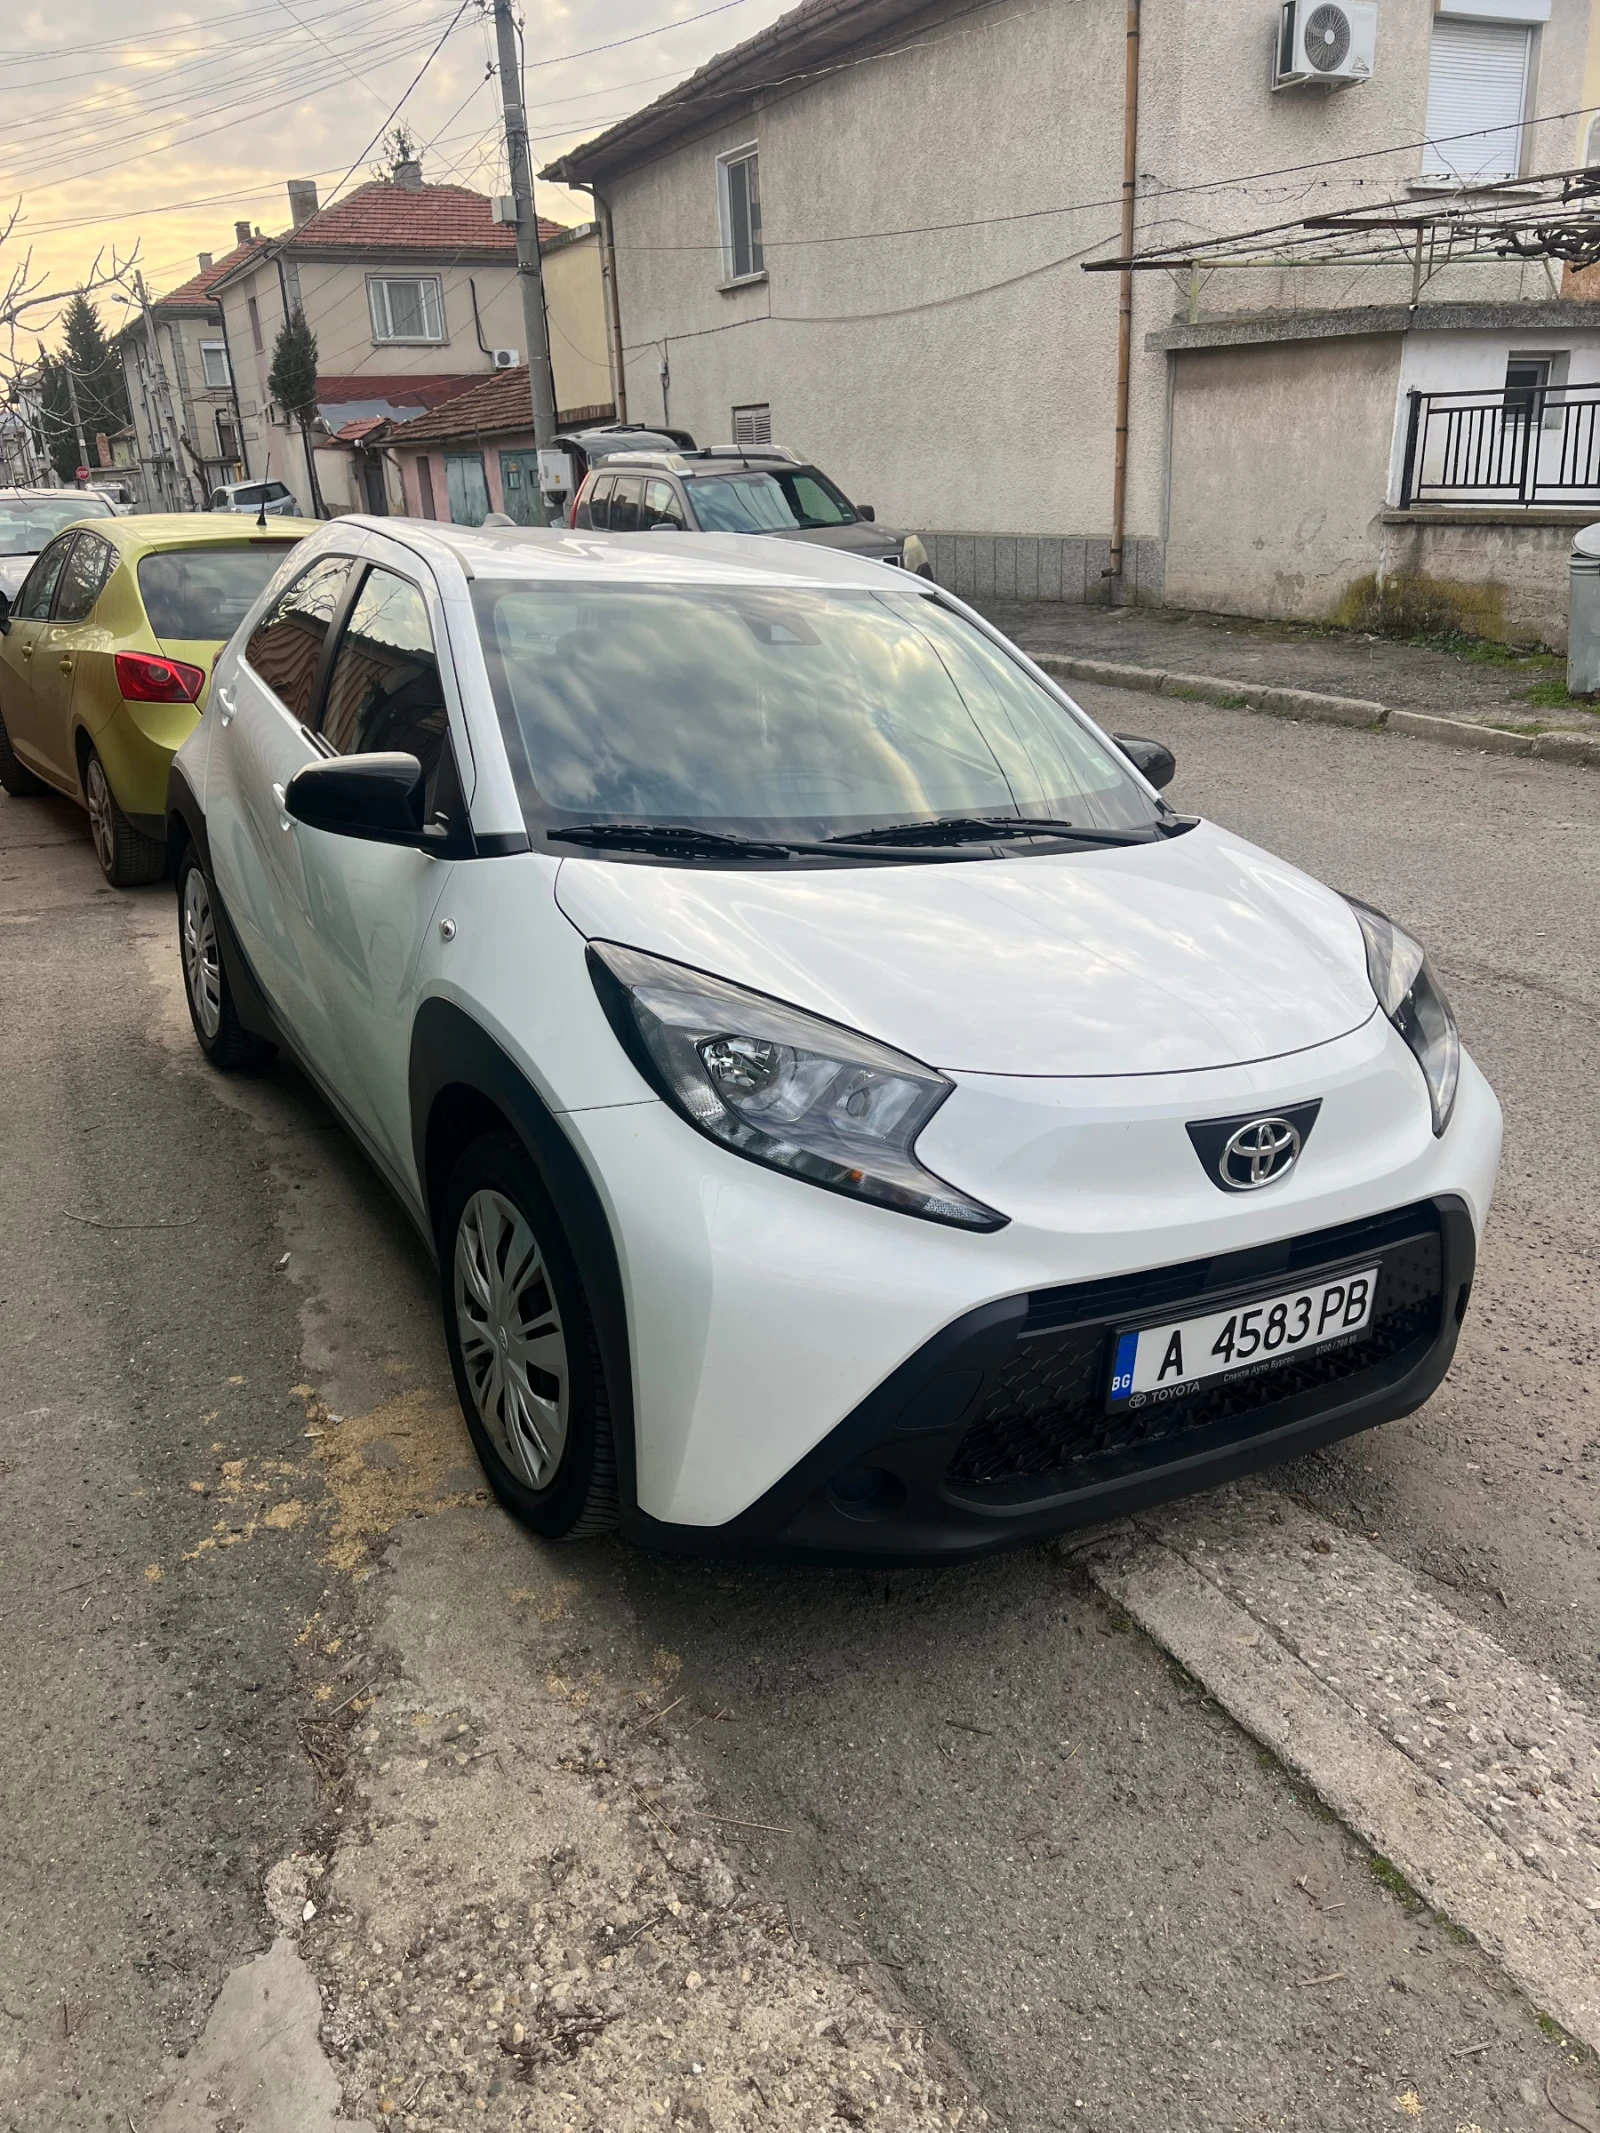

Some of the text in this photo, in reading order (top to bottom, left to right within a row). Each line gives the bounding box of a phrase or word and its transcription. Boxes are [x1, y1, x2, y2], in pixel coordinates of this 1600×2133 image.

[1157, 1330, 1183, 1381] A
[1250, 1363, 1269, 1375] Ауто
[1270, 1355, 1295, 1369] Бургас
[1111, 1373, 1131, 1392] BG
[1151, 1381, 1200, 1403] TOYOTA
